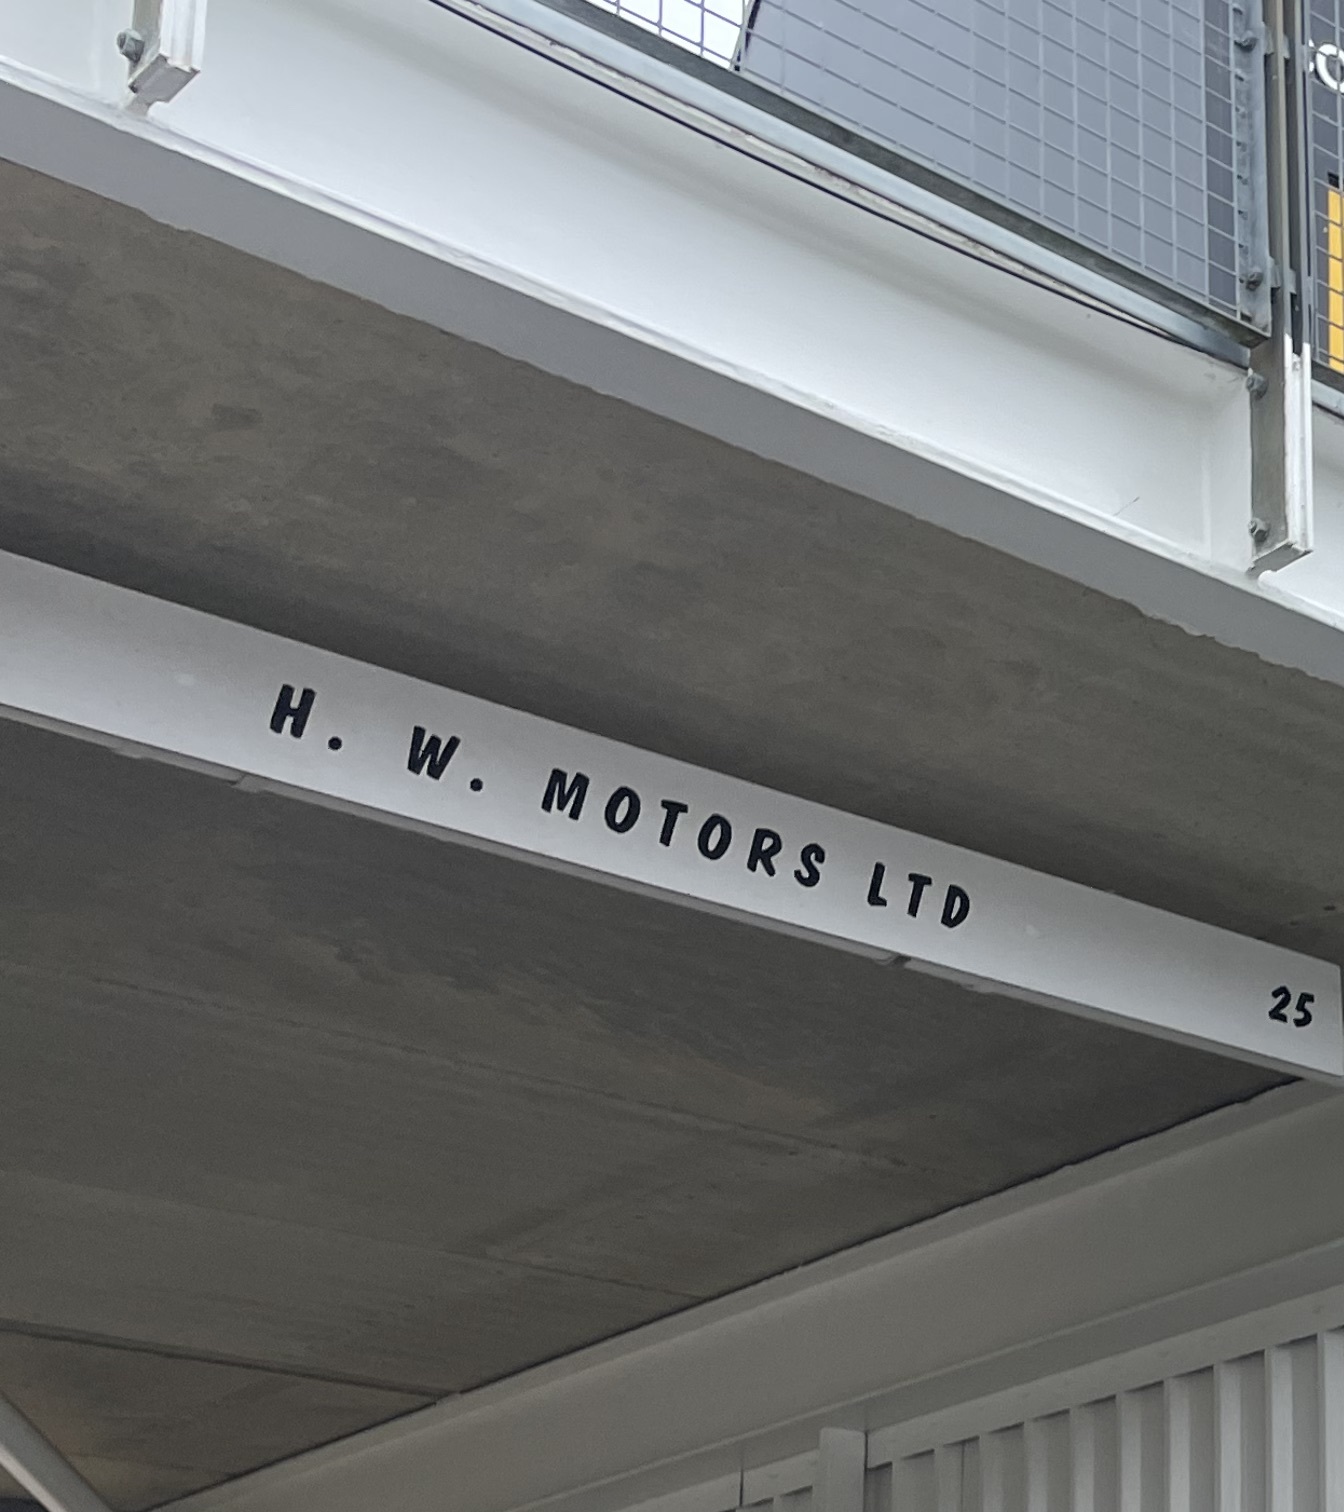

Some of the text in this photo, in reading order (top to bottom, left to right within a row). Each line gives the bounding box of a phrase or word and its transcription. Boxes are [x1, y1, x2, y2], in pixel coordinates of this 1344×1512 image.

[270, 683, 971, 928] H. W. MOTORS LTD
[1267, 985, 1315, 1028] 25
